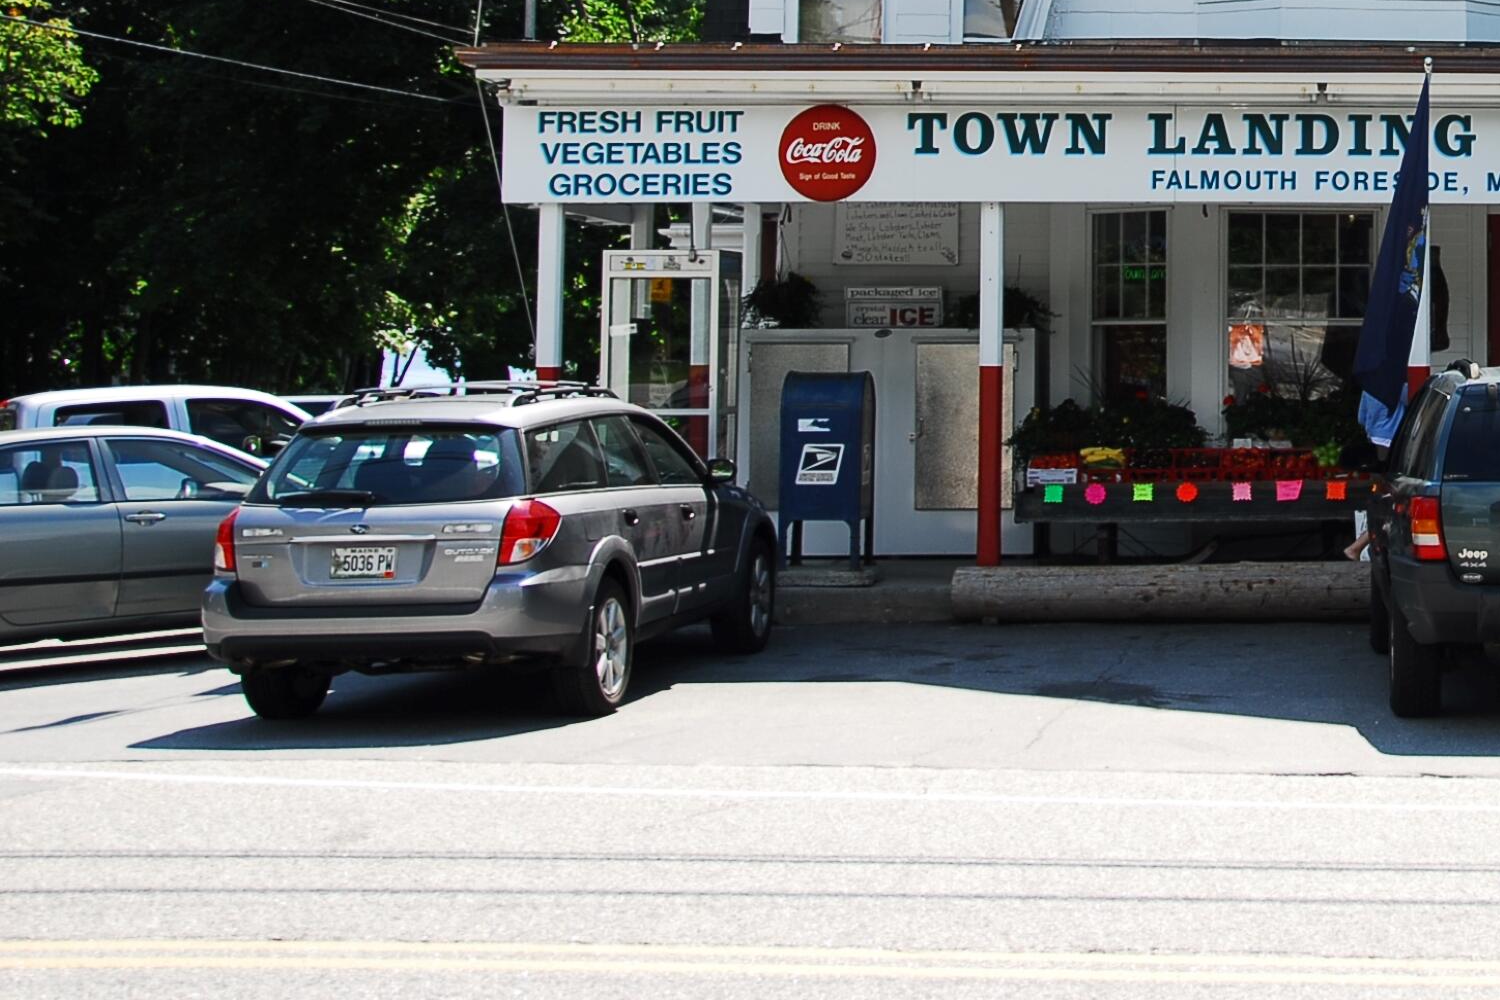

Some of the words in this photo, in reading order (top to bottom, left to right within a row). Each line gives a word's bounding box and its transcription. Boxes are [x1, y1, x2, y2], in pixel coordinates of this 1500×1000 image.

[538, 110, 642, 134] FRESH
[655, 110, 745, 134] FRUIT
[813, 121, 841, 132] DRINK
[908, 111, 1113, 156] TOWN
[1147, 112, 1477, 158] LANDING
[540, 141, 742, 165] VEGETABLES
[785, 136, 865, 165] Coca-Cola
[548, 172, 733, 197] GROCERIES
[1151, 169, 1297, 191] FALMOUTH
[1315, 170, 1469, 195] FOREDE,
[850, 287, 913, 298] packaged
[918, 288, 938, 297] ice
[854, 313, 887, 326] clear
[889, 305, 936, 327] ICE
[343, 554, 374, 572] 5036
[377, 554, 394, 571] PW
[1457, 548, 1488, 560] Jeep
